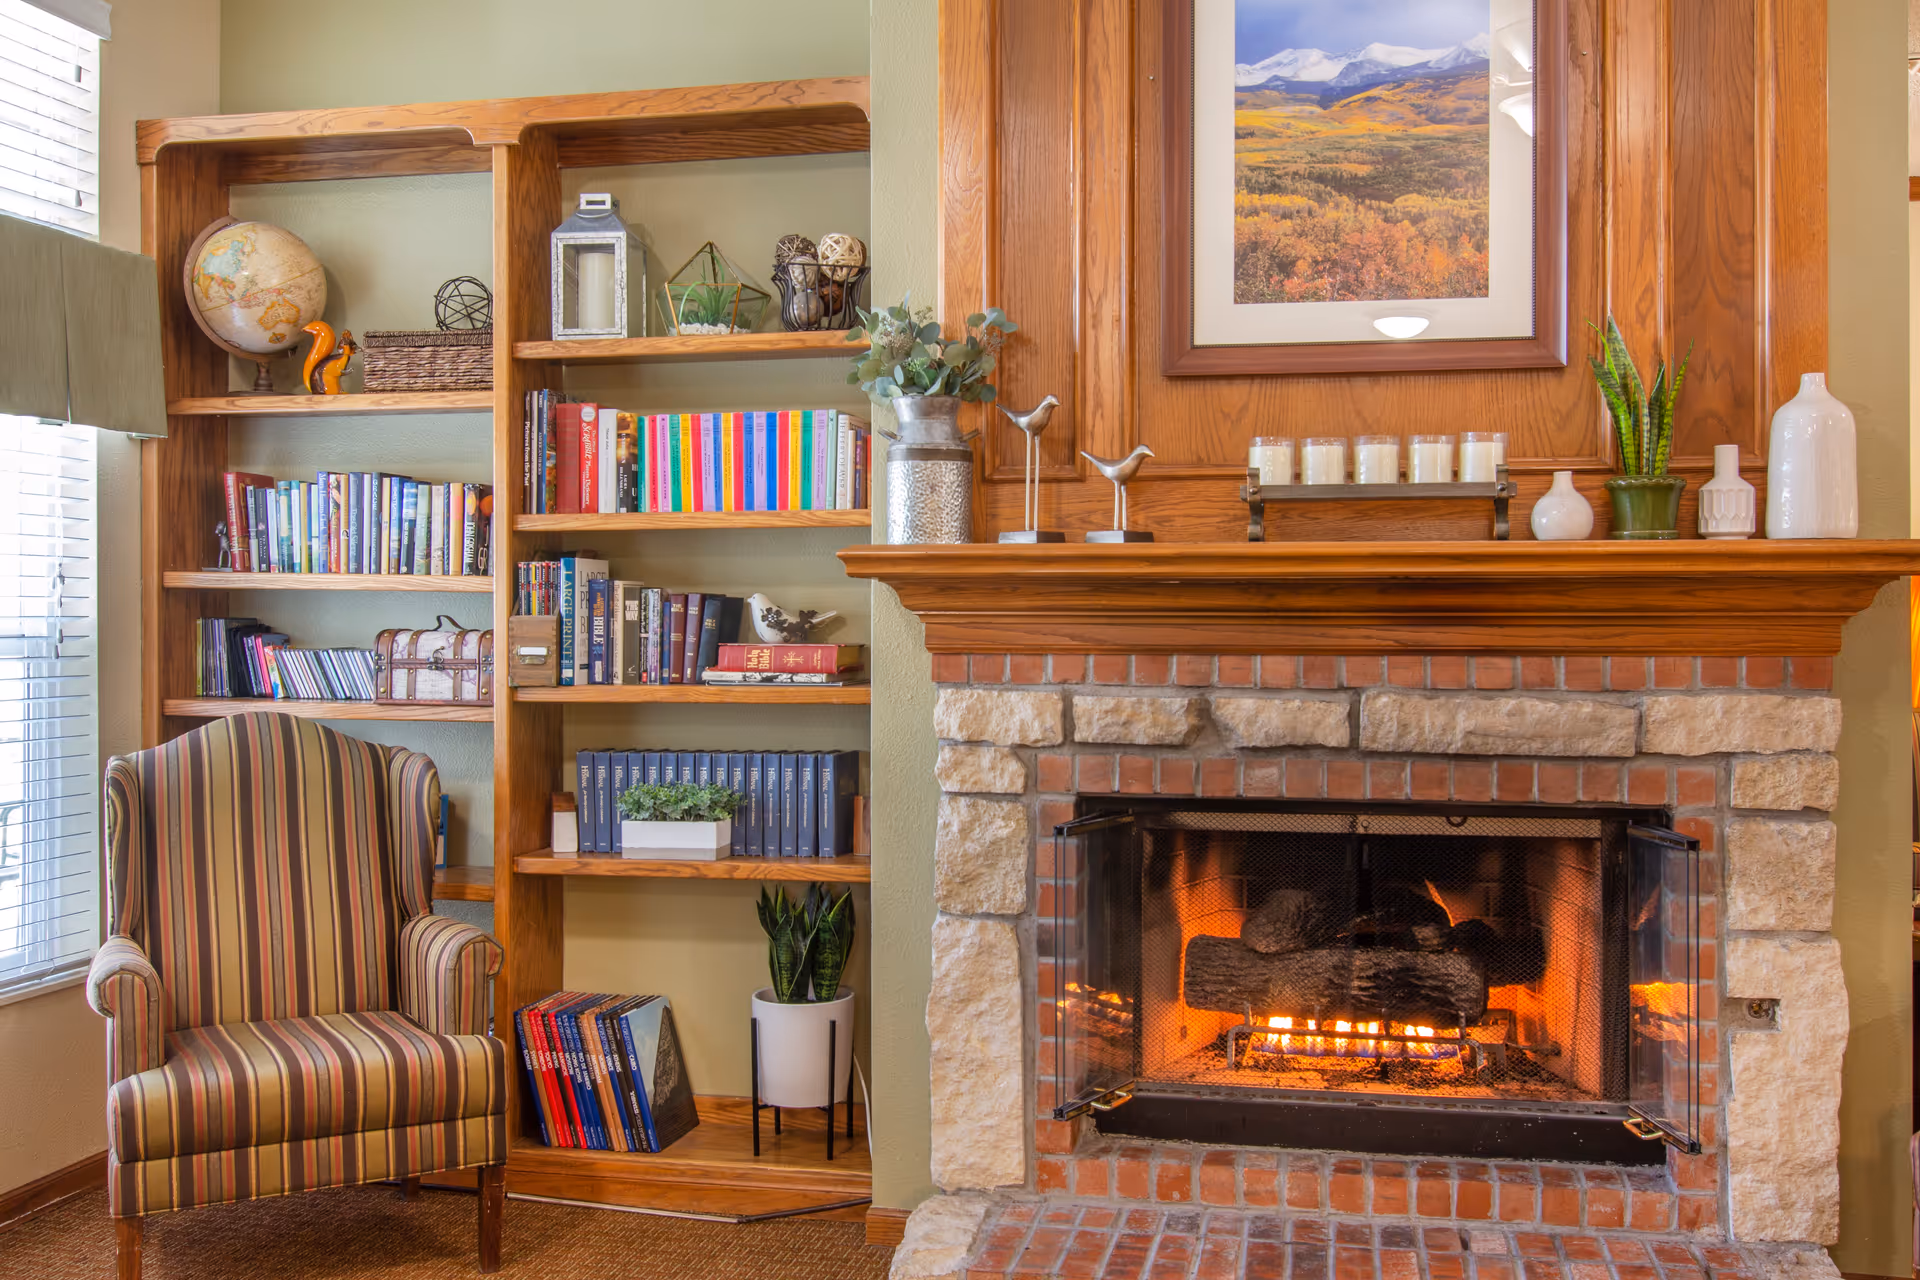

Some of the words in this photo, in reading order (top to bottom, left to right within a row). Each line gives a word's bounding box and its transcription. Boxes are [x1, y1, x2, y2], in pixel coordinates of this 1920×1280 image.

[582, 422, 592, 460] SCRABBLE
[563, 571, 572, 614] LARGE
[625, 601, 638, 610] THE
[625, 611, 638, 620] WAY
[563, 618, 572, 658] PRINT
[593, 616, 604, 644] BIBLE
[747, 649, 760, 668] Holy
[759, 648, 770, 669] Bible
[581, 766, 589, 788] HYMNAL
[538, 1049, 546, 1071] LONDON
[565, 1052, 573, 1075] MOSCOW
[583, 1069, 591, 1089] JANEIRO
